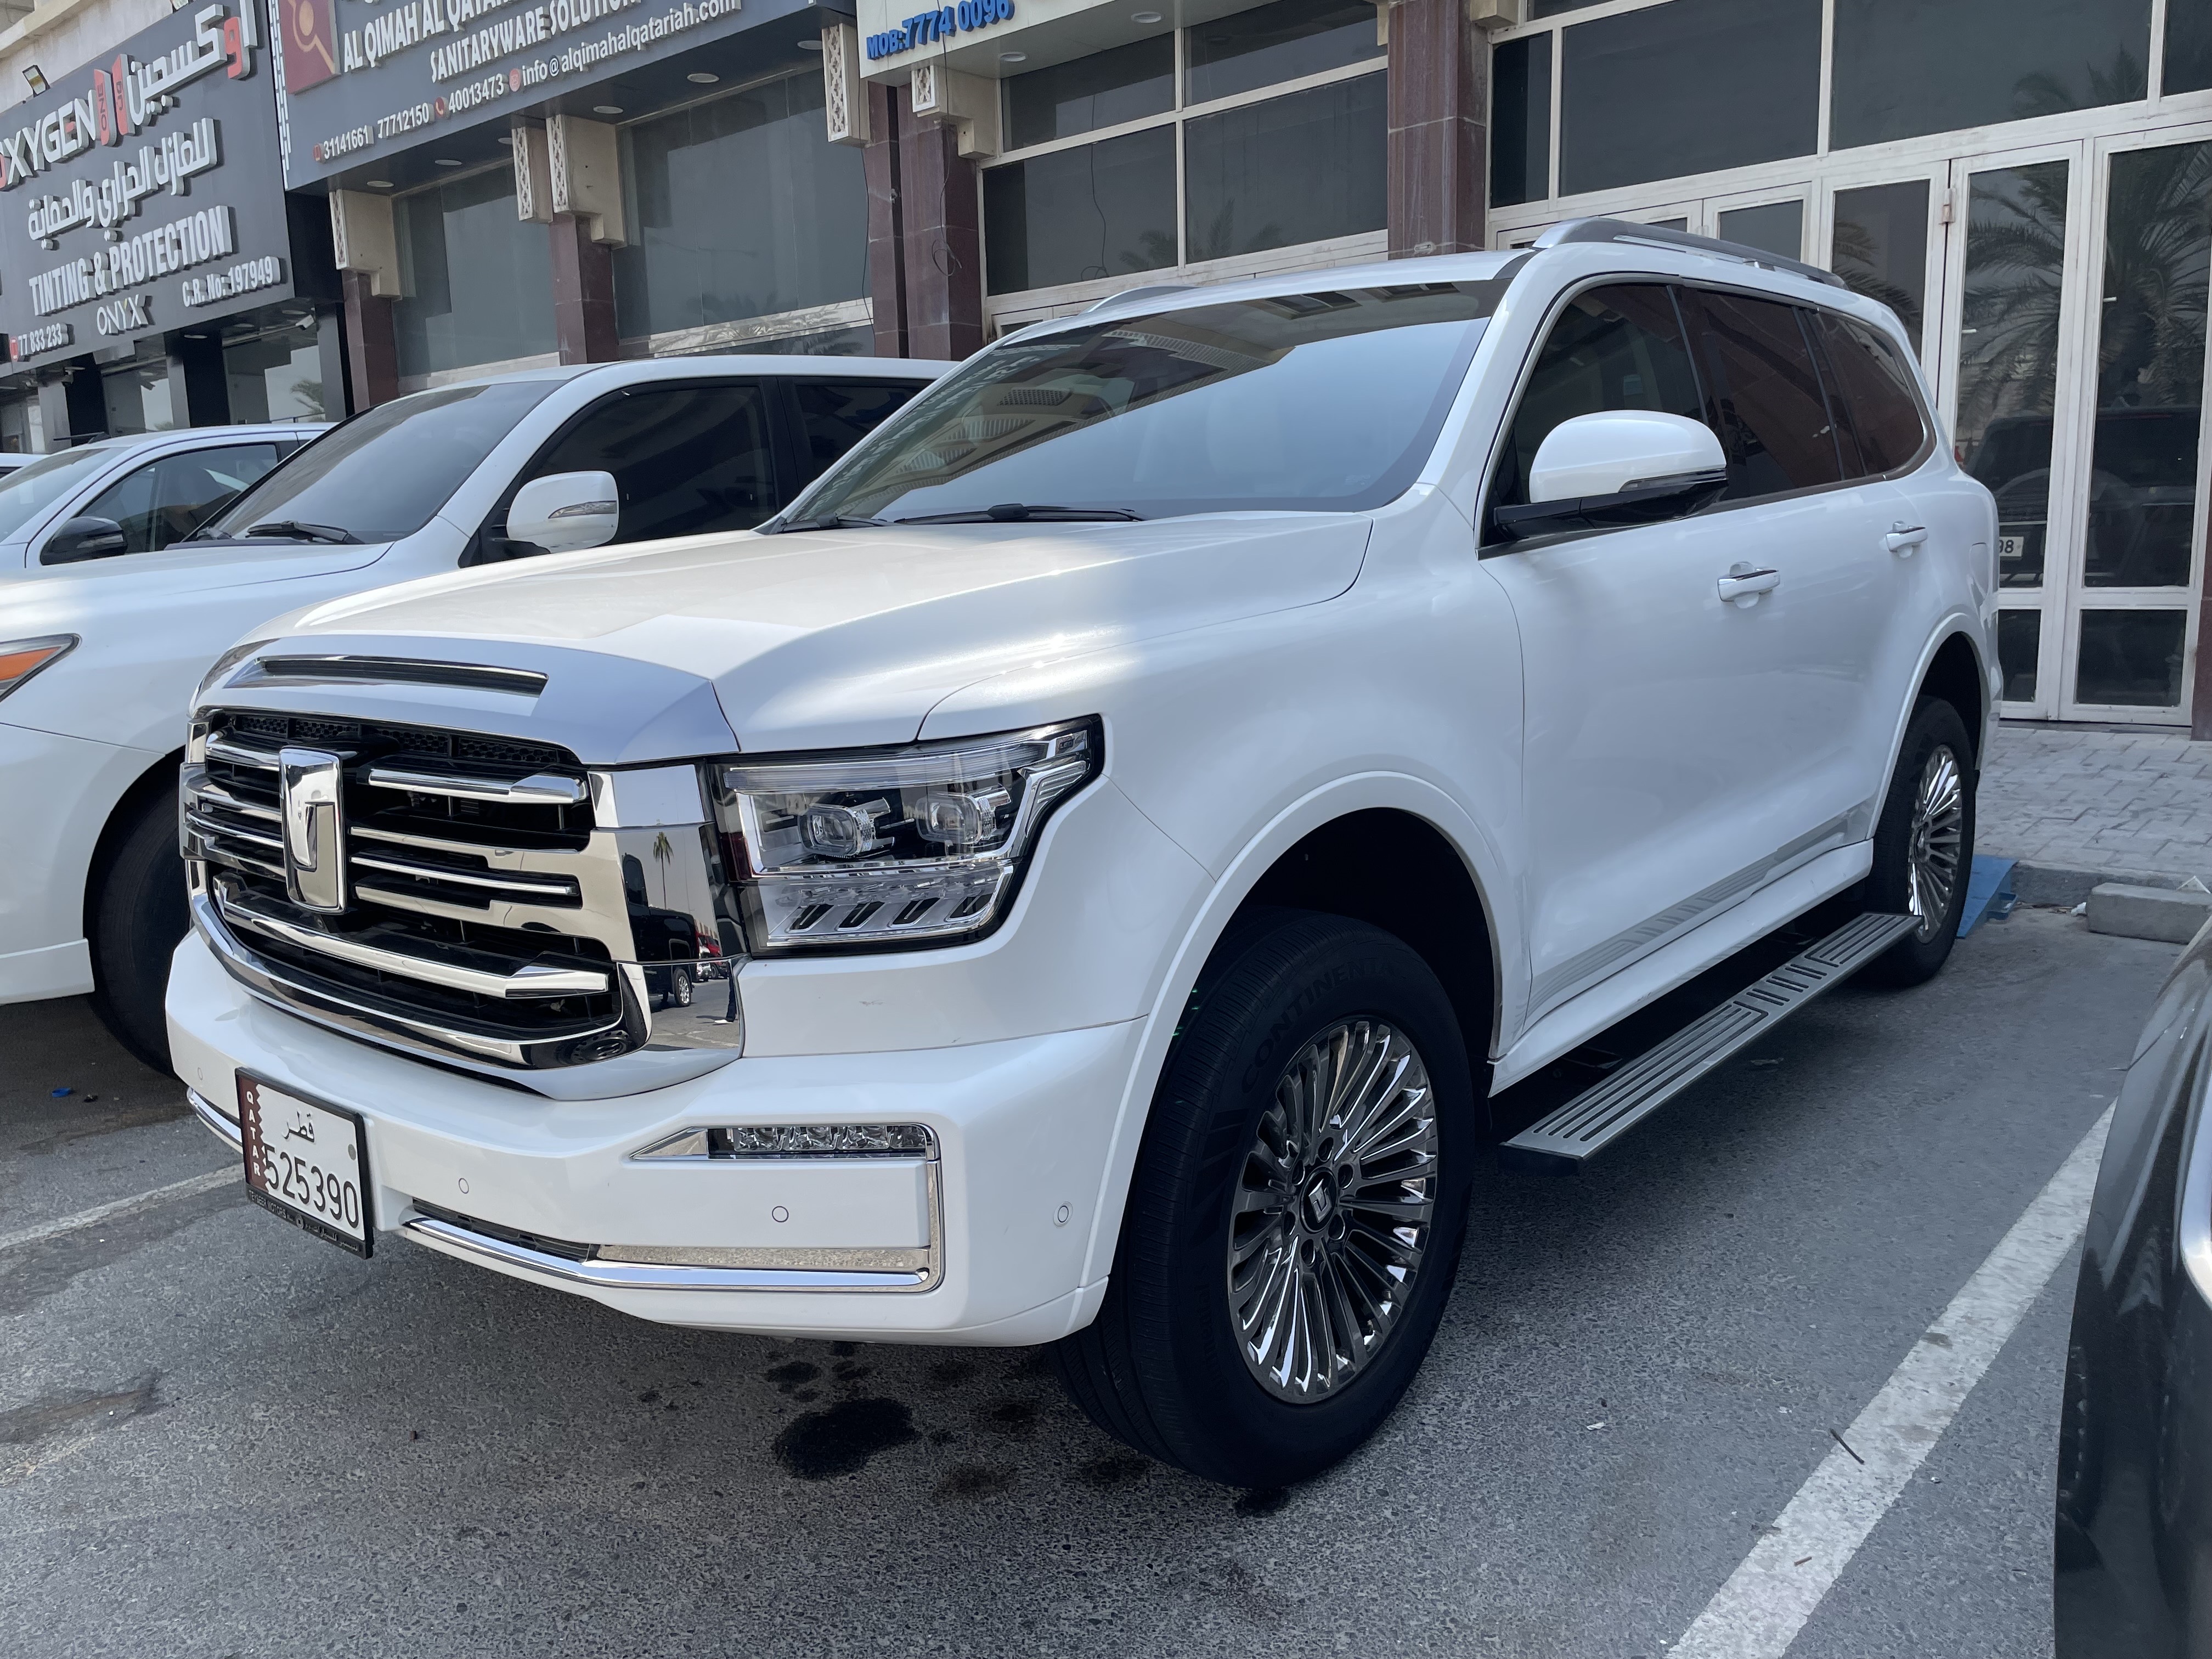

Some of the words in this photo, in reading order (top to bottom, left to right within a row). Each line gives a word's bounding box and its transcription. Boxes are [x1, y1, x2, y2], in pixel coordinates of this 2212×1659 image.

[344, 30, 363, 72] AL
[364, 2, 419, 68] QIMAH
[423, 0, 445, 39] AL
[430, 6, 546, 83] SANITARYWARE
[323, 125, 369, 160] 31141661
[377, 102, 430, 139] 77712150
[448, 73, 505, 113] 40013473
[29, 258, 90, 316] TINTING
[93, 251, 108, 295] &
[109, 205, 227, 289] PROTECTION
[228, 256, 274, 294] 197949
[18, 334, 28, 356] 77
[30, 328, 46, 353] 833
[46, 323, 63, 348] 233
[97, 294, 142, 336] ONYX
[1241, 953, 1404, 1094] CONTINENTA
[246, 1091, 261, 1176] QATAR
[283, 1108, 315, 1142] قطر
[264, 1144, 359, 1229] 525390
